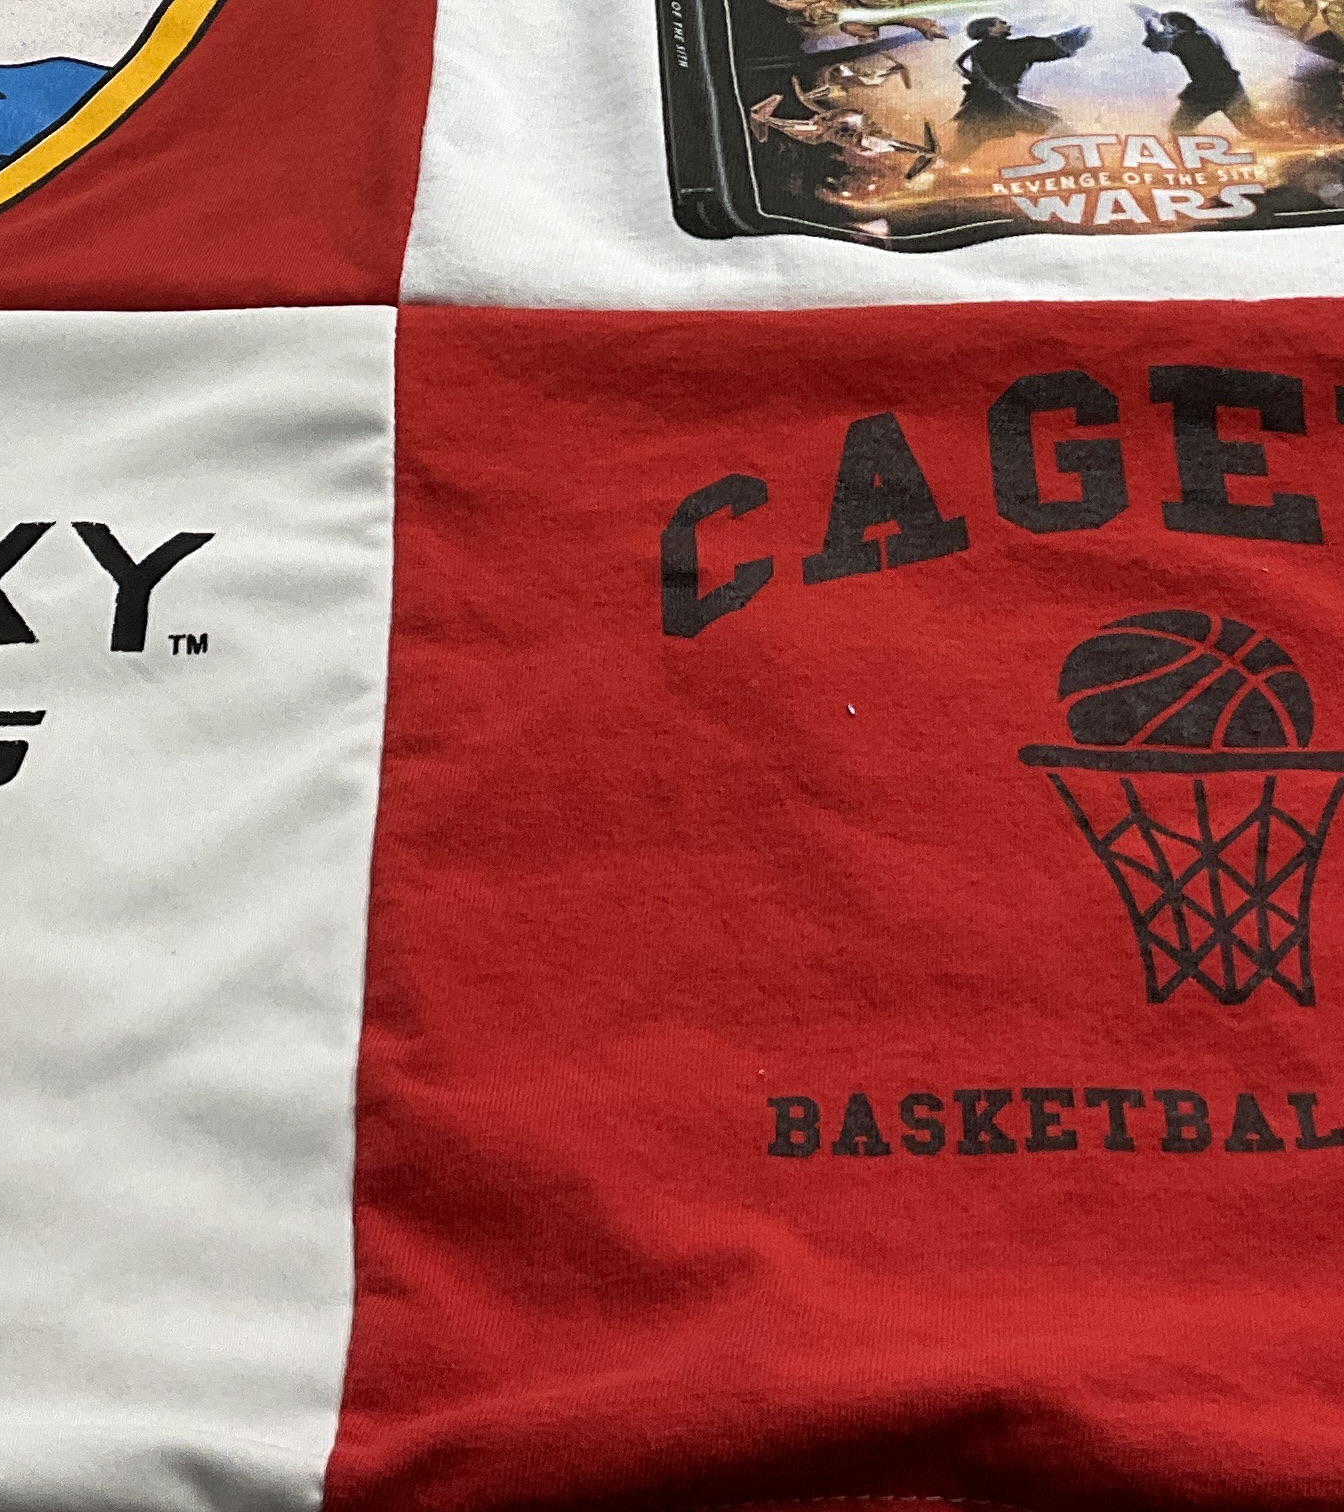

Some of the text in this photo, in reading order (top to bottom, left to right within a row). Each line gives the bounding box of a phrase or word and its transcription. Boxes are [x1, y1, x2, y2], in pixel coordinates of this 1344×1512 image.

[999, 134, 1256, 179] STAR
[991, 172, 1112, 195] REVENGE
[1121, 172, 1153, 186] OF
[1163, 172, 1209, 186] THE
[1010, 182, 1265, 226] WARS
